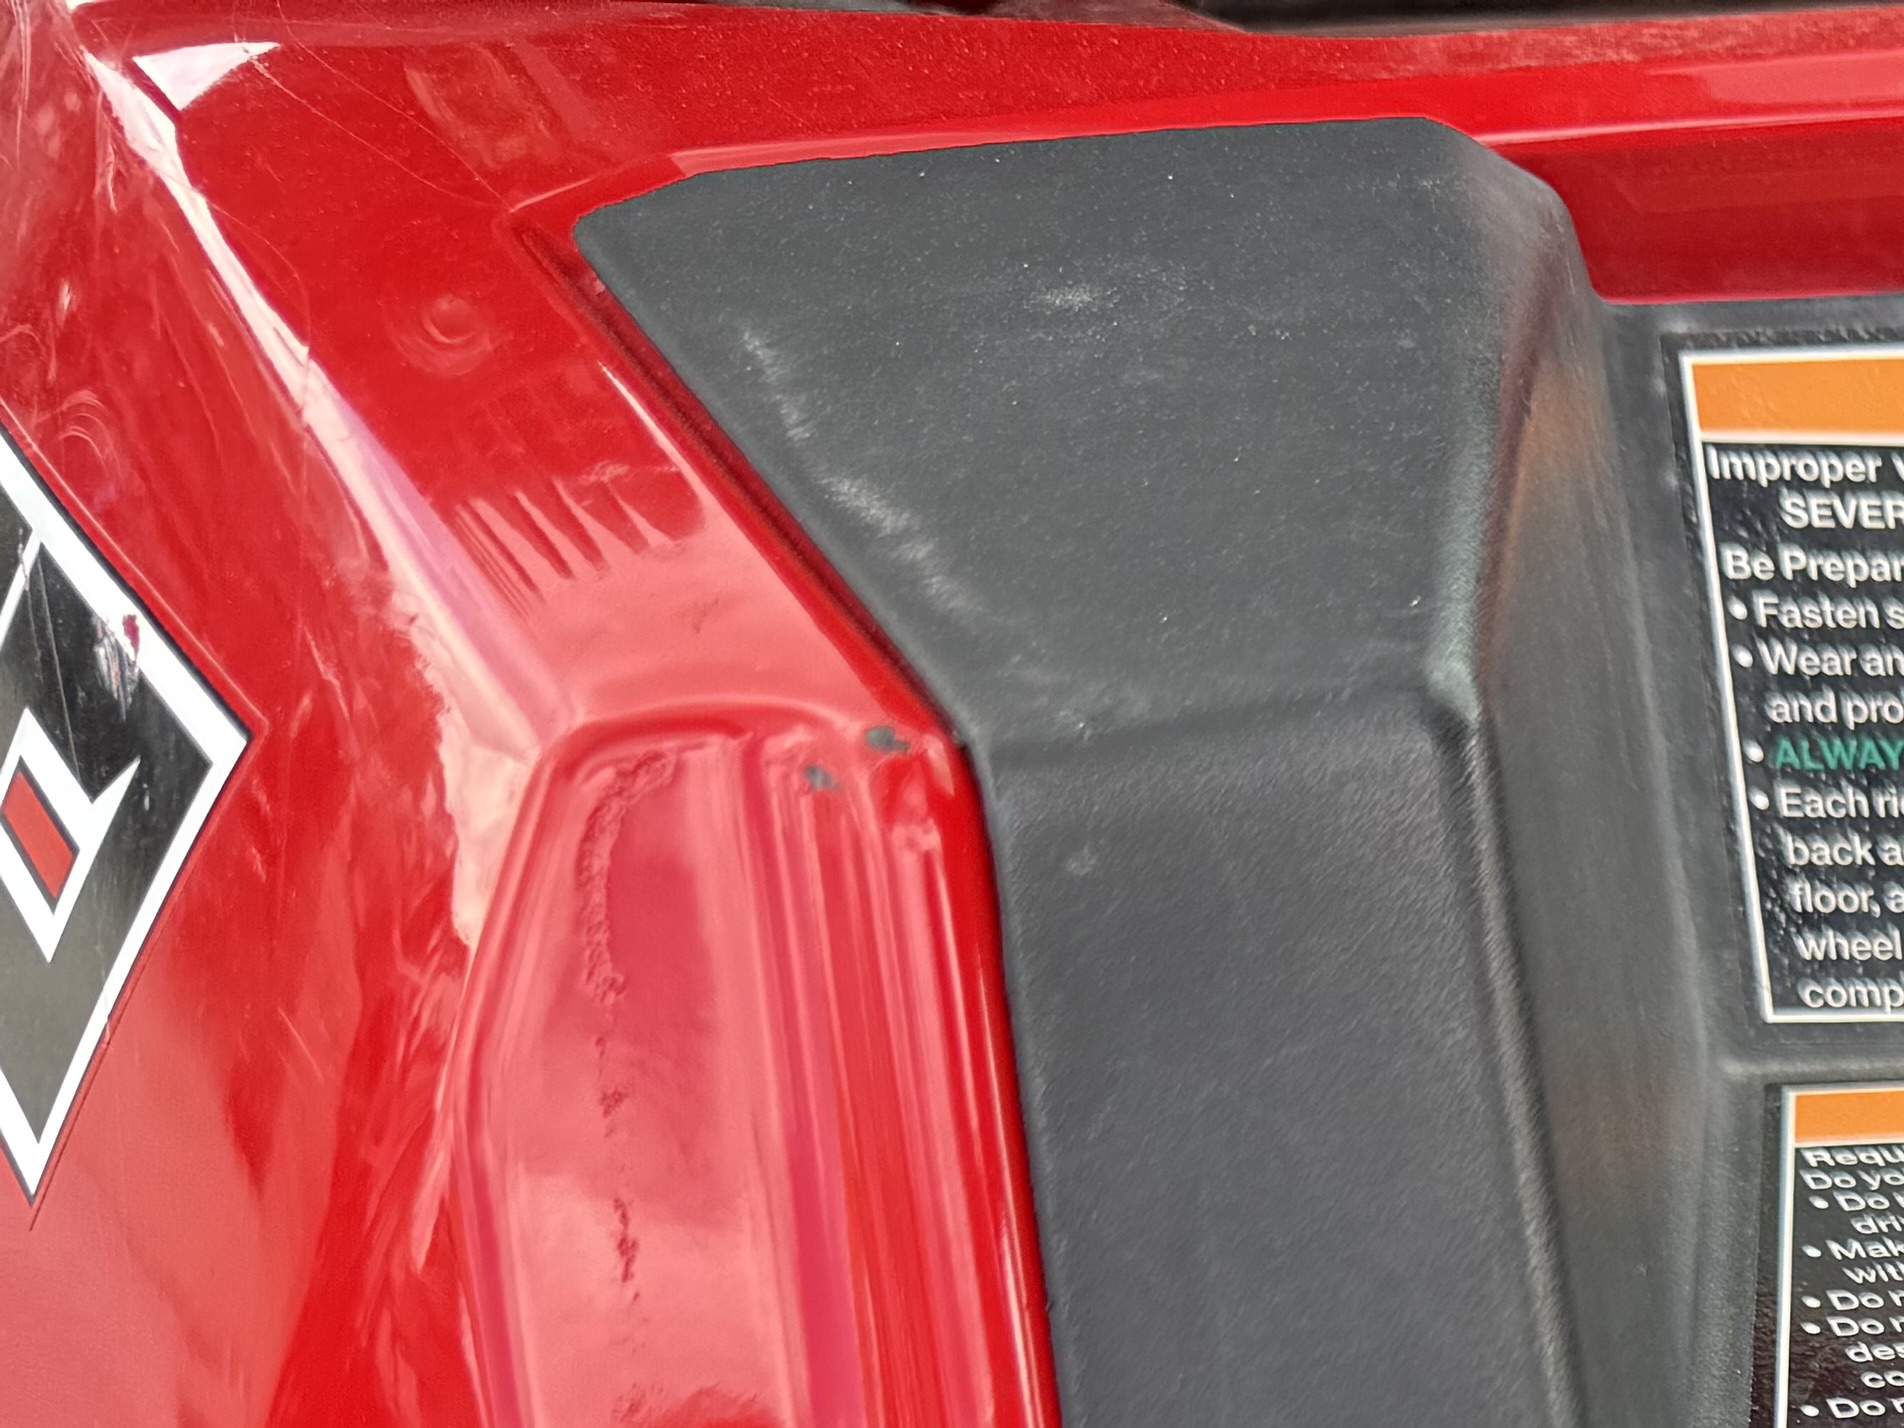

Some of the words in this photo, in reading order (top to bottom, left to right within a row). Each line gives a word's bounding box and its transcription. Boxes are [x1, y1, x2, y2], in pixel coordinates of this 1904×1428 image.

[1720, 546, 1775, 580] Be
[1753, 594, 1880, 628] Fasten
[1757, 641, 1857, 678] Wear
[1767, 690, 1838, 730] and
[1775, 785, 1870, 818] Each
[1785, 832, 1876, 868] back
[1827, 1290, 1885, 1311] Do
[1826, 1397, 1886, 1419] Do
